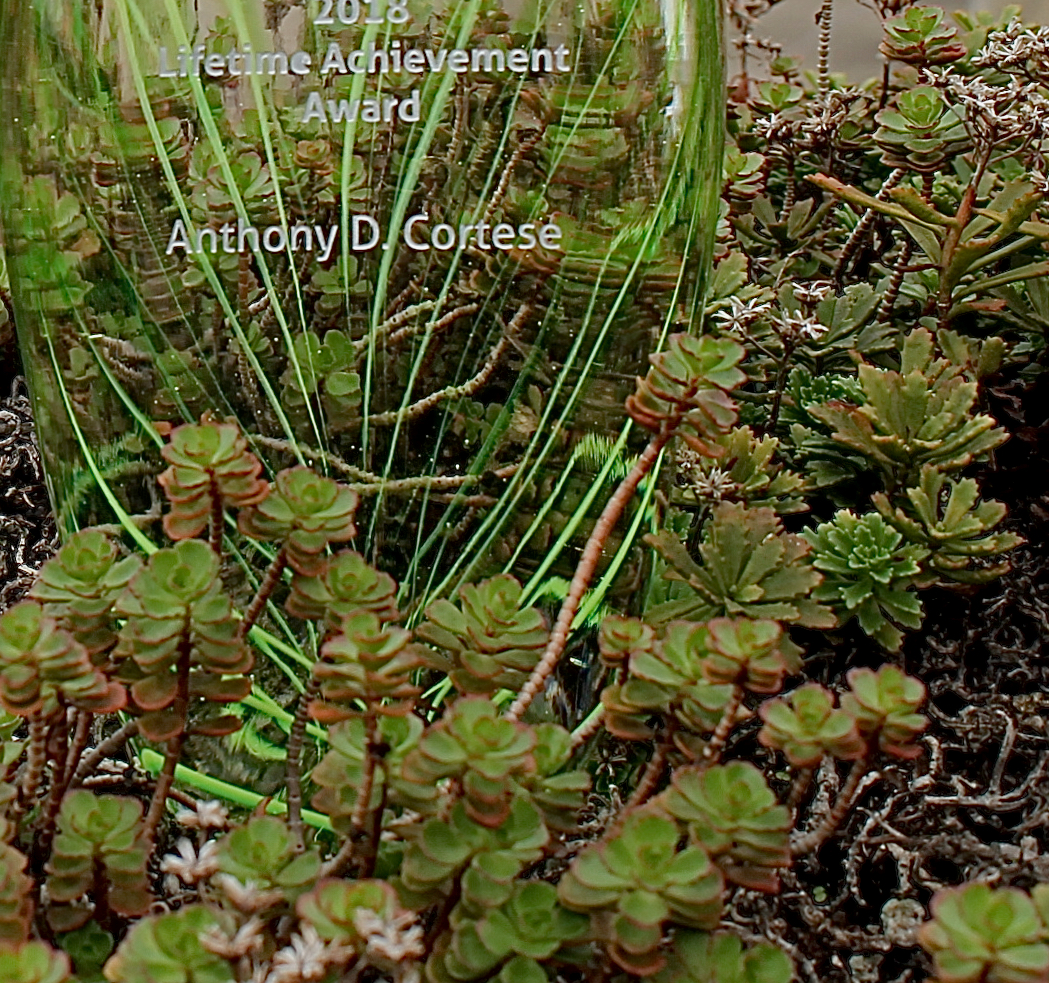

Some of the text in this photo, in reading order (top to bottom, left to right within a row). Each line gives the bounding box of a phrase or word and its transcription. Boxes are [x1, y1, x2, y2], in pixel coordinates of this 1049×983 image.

[159, 40, 571, 78] Lifetime Achievement
[301, 89, 421, 124] Award
[165, 213, 563, 262] Anthony D. Cortese
